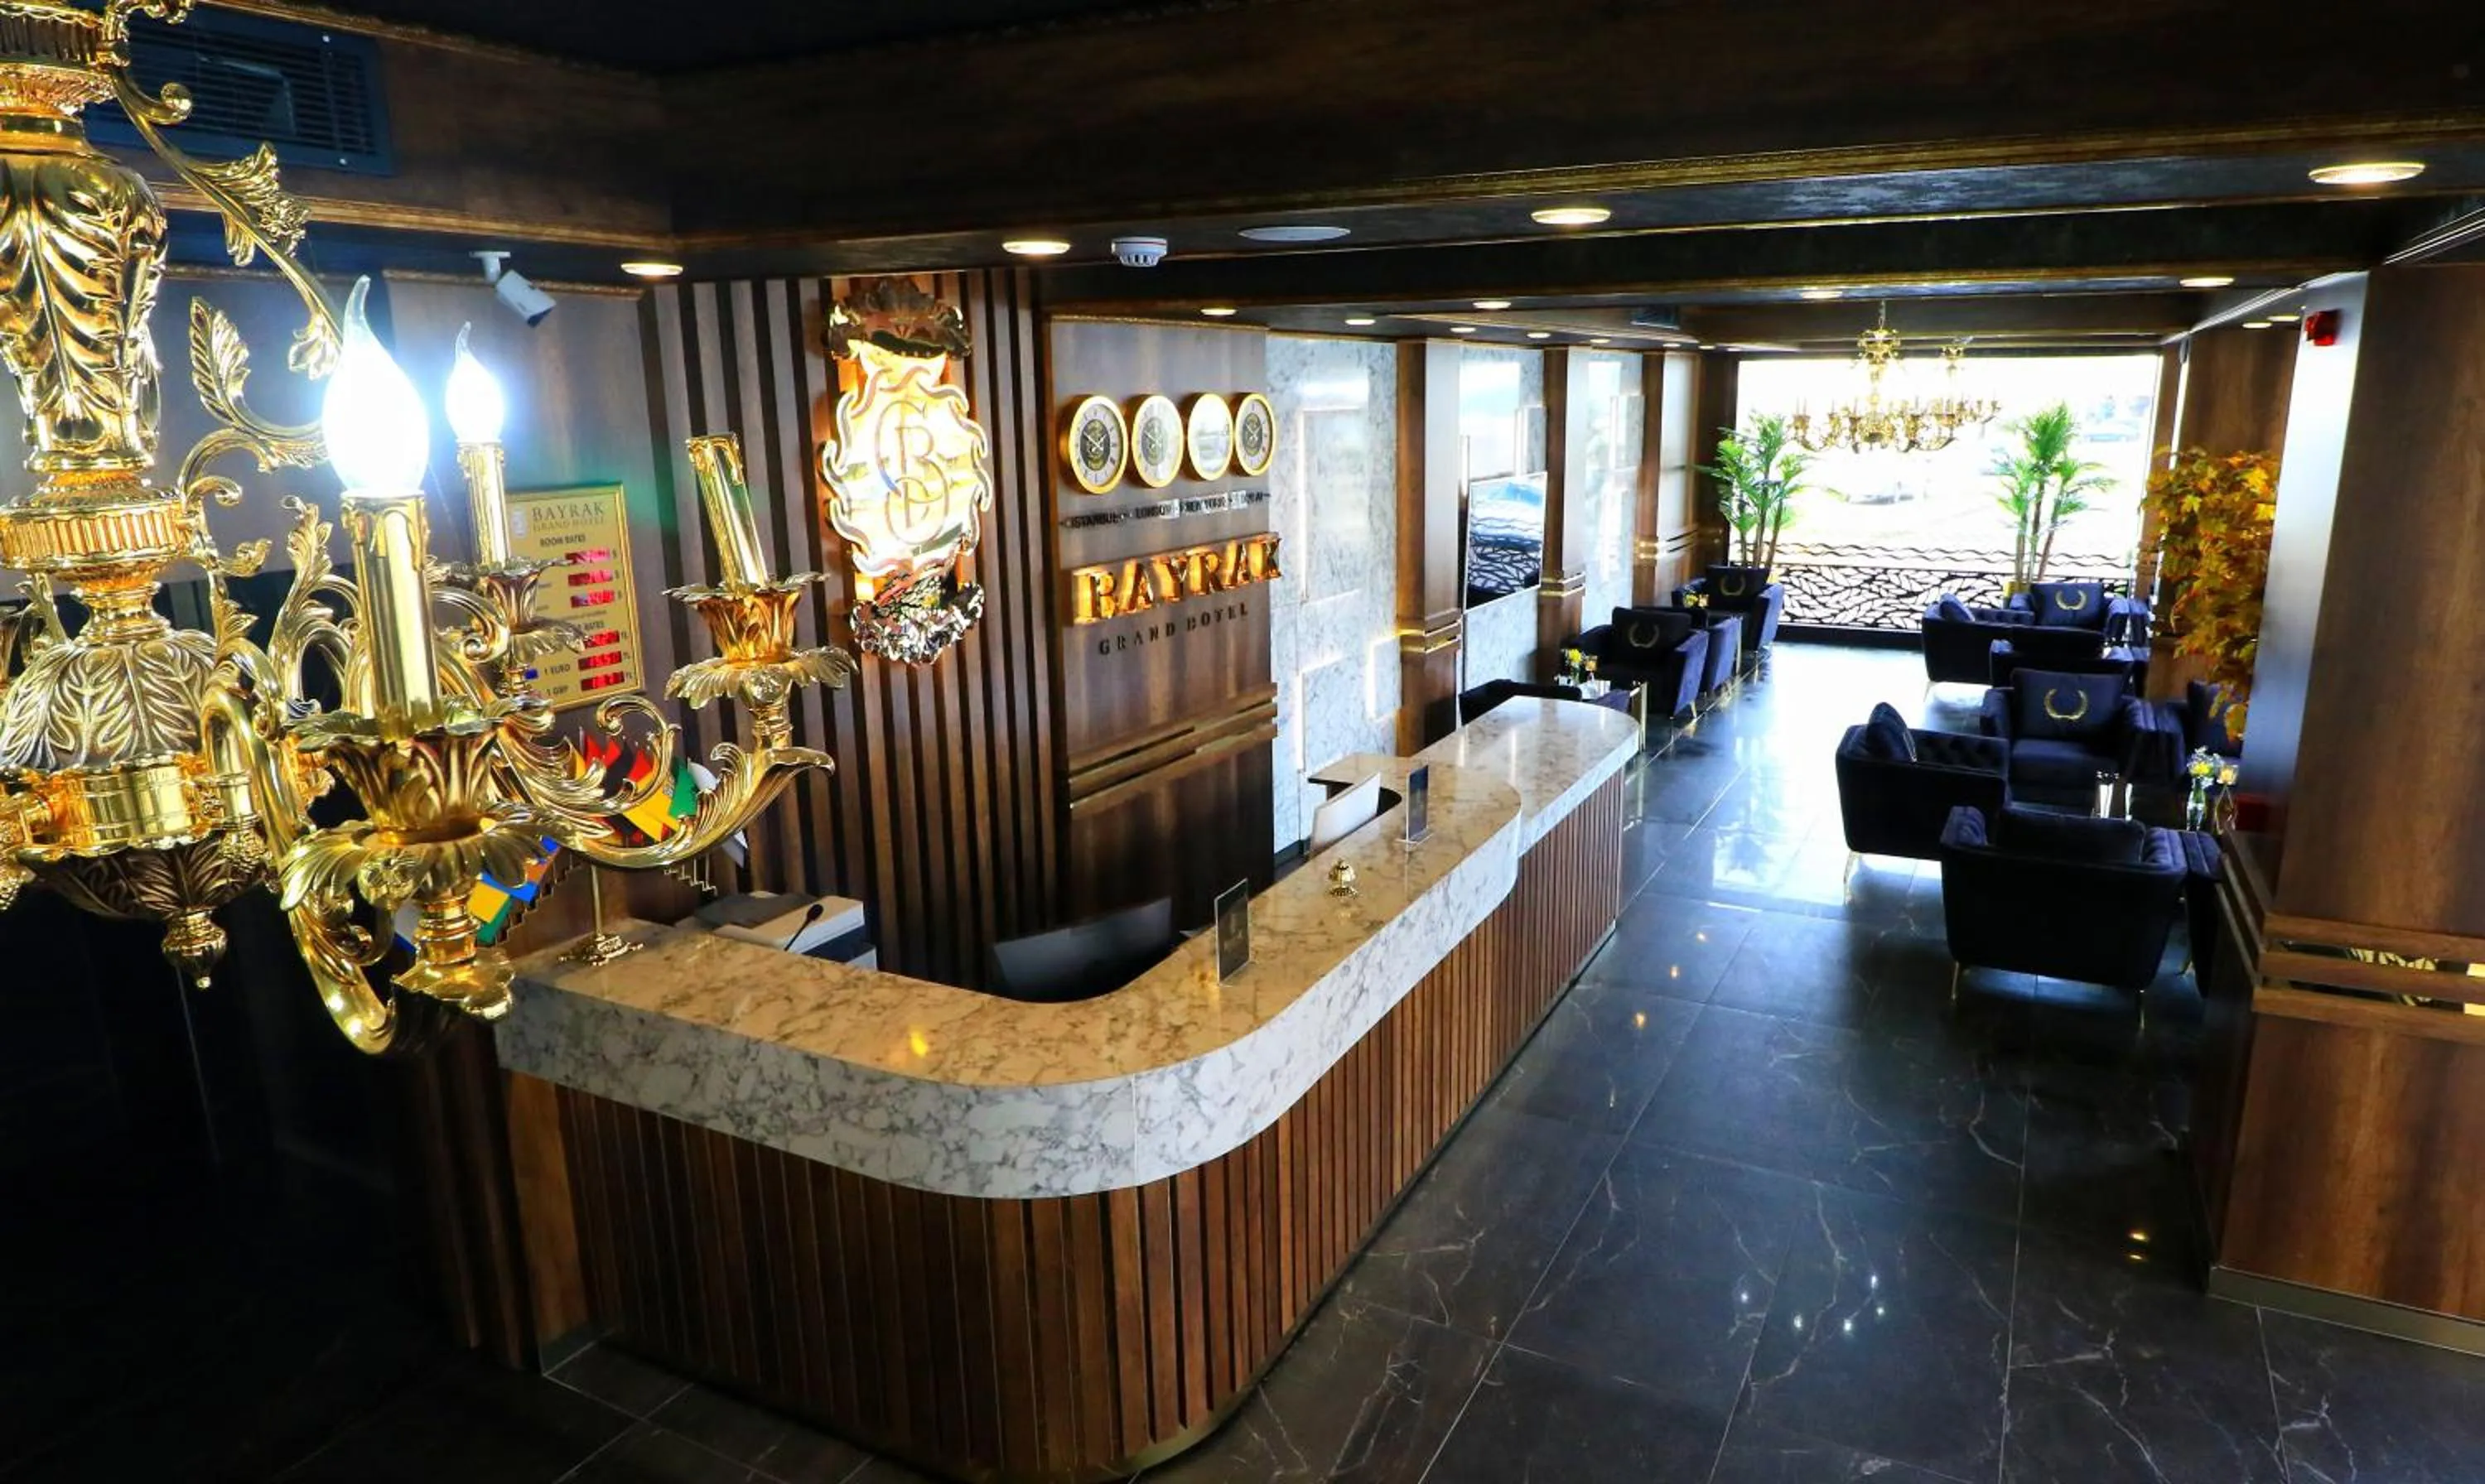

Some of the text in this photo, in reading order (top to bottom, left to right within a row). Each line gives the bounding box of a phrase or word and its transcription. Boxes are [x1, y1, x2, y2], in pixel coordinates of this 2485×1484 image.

[532, 501, 604, 522] BAYRAK
[1072, 532, 1282, 624] BAYRAK
[1098, 602, 1248, 656] GRAND HOTEL
[550, 663, 571, 675] EURO
